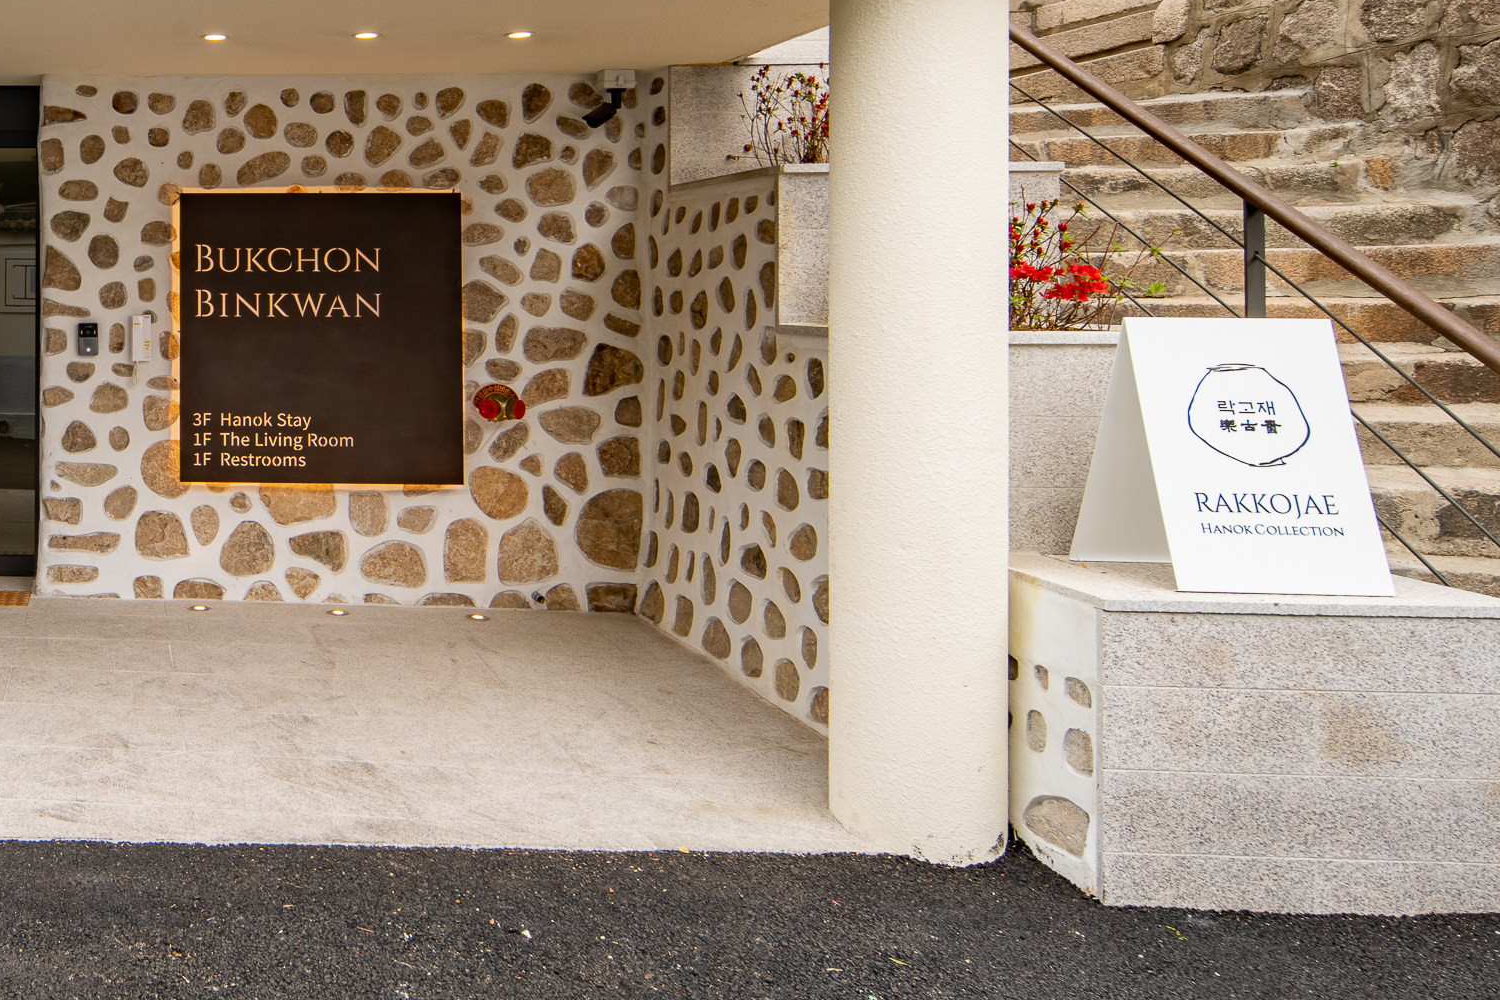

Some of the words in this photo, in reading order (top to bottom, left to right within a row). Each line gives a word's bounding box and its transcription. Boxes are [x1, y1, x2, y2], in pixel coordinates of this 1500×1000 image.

[194, 243, 381, 273] BUKCHON
[194, 289, 381, 318] BINKWAN
[1217, 400, 1276, 416] 락고재
[192, 412, 212, 427] 3F
[220, 411, 273, 427] Hanok
[276, 412, 312, 431] Stay
[193, 432, 212, 447] 1F
[220, 431, 250, 447] The
[255, 431, 303, 451] Living
[307, 432, 354, 447] Room
[193, 452, 212, 467] 1F
[220, 452, 307, 467] Restrooms
[1194, 492, 1339, 520] RAKKOJAE
[1201, 522, 1253, 535] HANOK
[1254, 523, 1345, 537] COLLECTION
